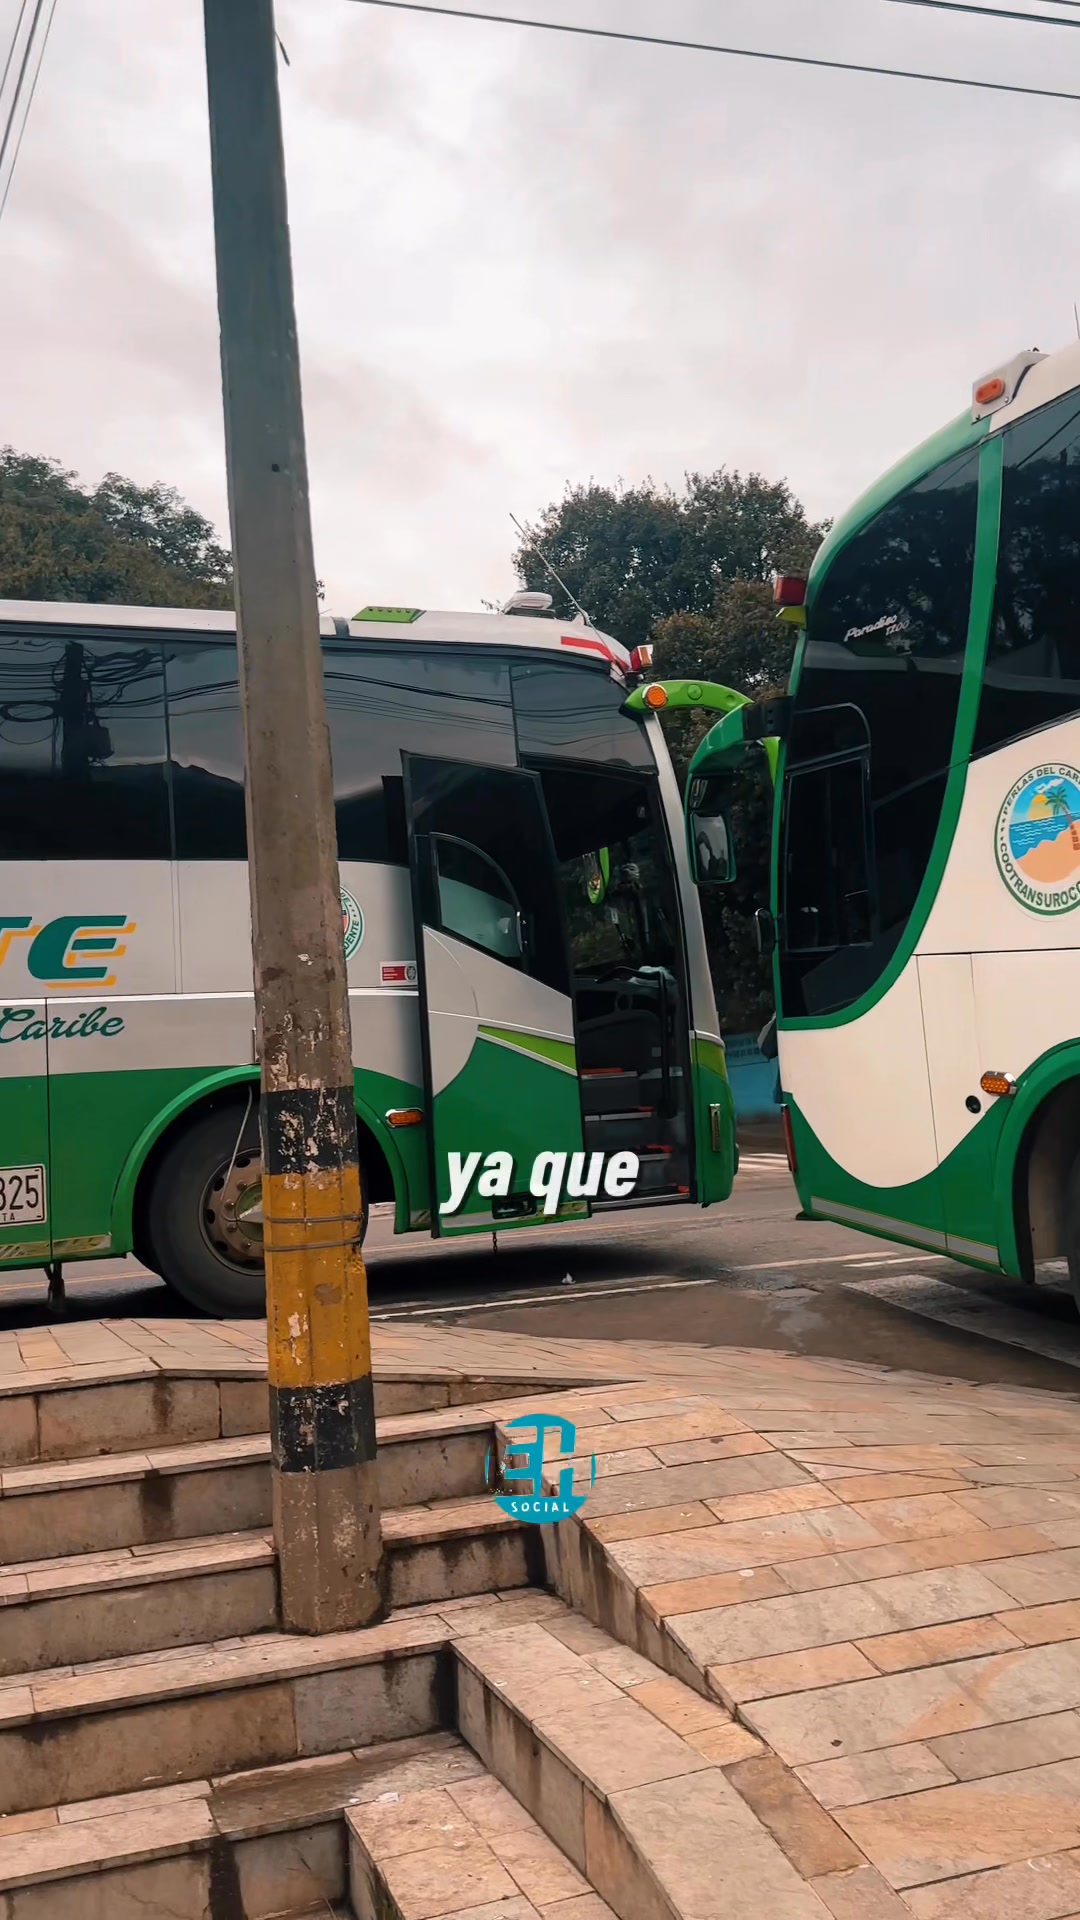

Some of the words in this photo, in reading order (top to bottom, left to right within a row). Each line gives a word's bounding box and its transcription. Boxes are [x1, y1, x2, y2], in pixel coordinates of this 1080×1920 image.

[843, 614, 897, 642] Paradiso
[1003, 773, 1035, 816] PERLAS
[1036, 766, 1056, 778] DEL
[0, 1006, 125, 1044] Caribe
